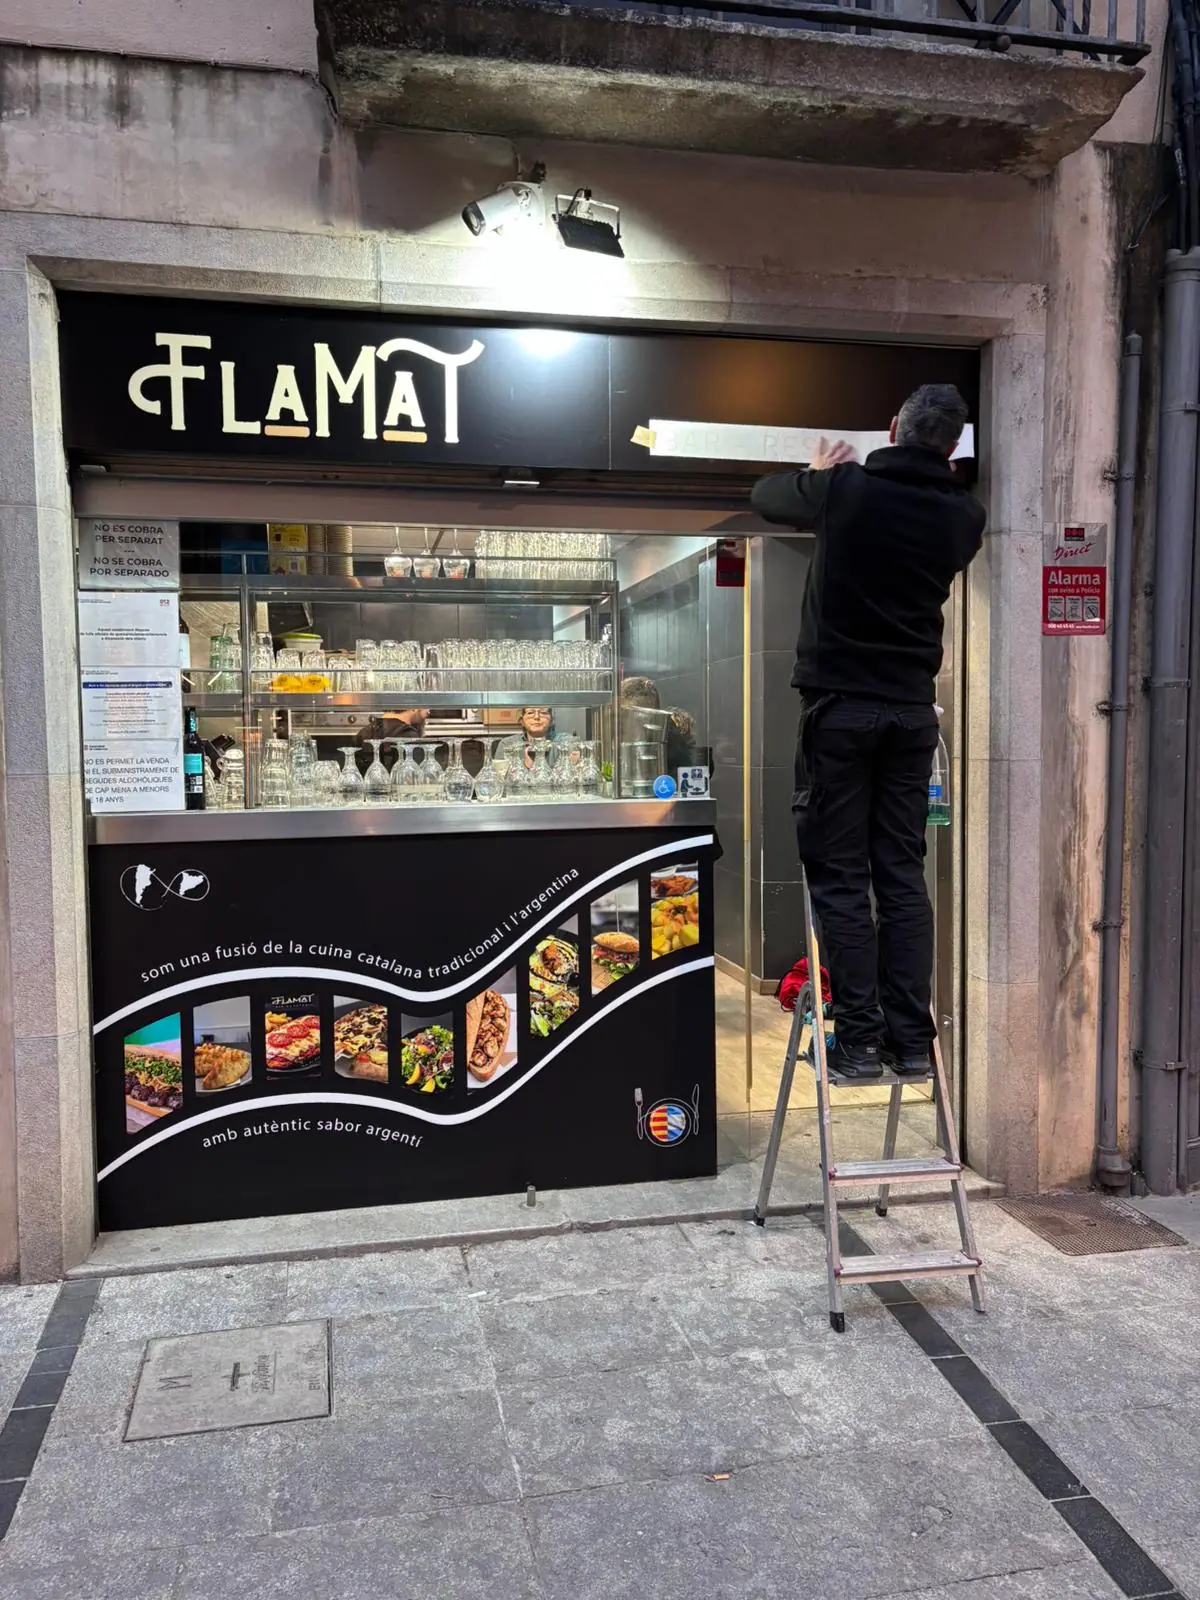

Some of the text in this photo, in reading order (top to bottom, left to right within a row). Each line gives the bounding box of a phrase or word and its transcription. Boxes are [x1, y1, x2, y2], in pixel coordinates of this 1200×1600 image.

[128, 332, 485, 443] FLAMAT
[94, 523, 164, 534] NO ES COBRA
[95, 534, 164, 545] PER SEPARAT
[93, 556, 163, 567] NO SE COBRA
[90, 567, 170, 578] POR SEPARADO
[1048, 569, 1101, 585] Alarma
[102, 767, 168, 775] SUBMINISTRAMENT
[139, 785, 170, 793] MENORS
[140, 868, 579, 982] som una fusió de la cuina catalana tradicional i l'argentina
[271, 993, 316, 1005] FLAMAT
[202, 1118, 424, 1148] amb autèntic sabor argentí
